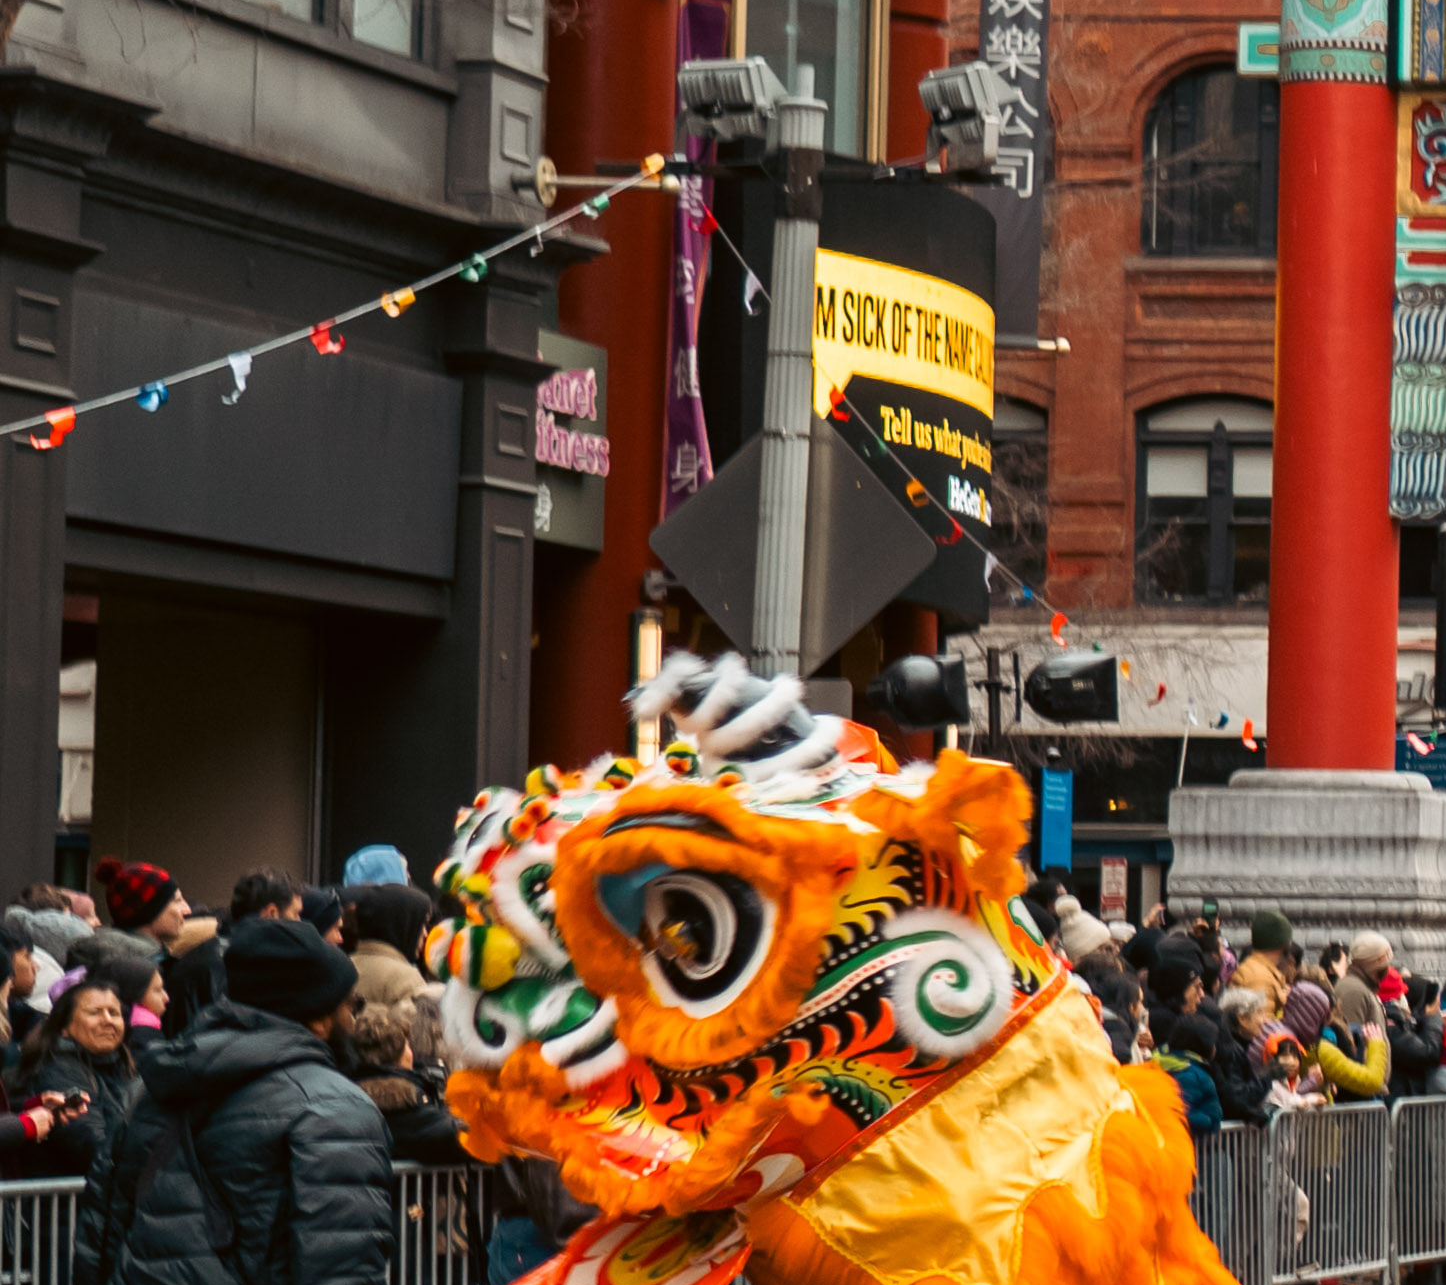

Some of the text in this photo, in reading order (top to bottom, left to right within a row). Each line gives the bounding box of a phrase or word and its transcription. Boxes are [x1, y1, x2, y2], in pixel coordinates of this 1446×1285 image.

[842, 291, 886, 350] SICK
[892, 299, 912, 358] OF
[916, 308, 941, 364] THE
[880, 404, 912, 446] Tell
[914, 420, 933, 451] us
[933, 417, 961, 459] what
